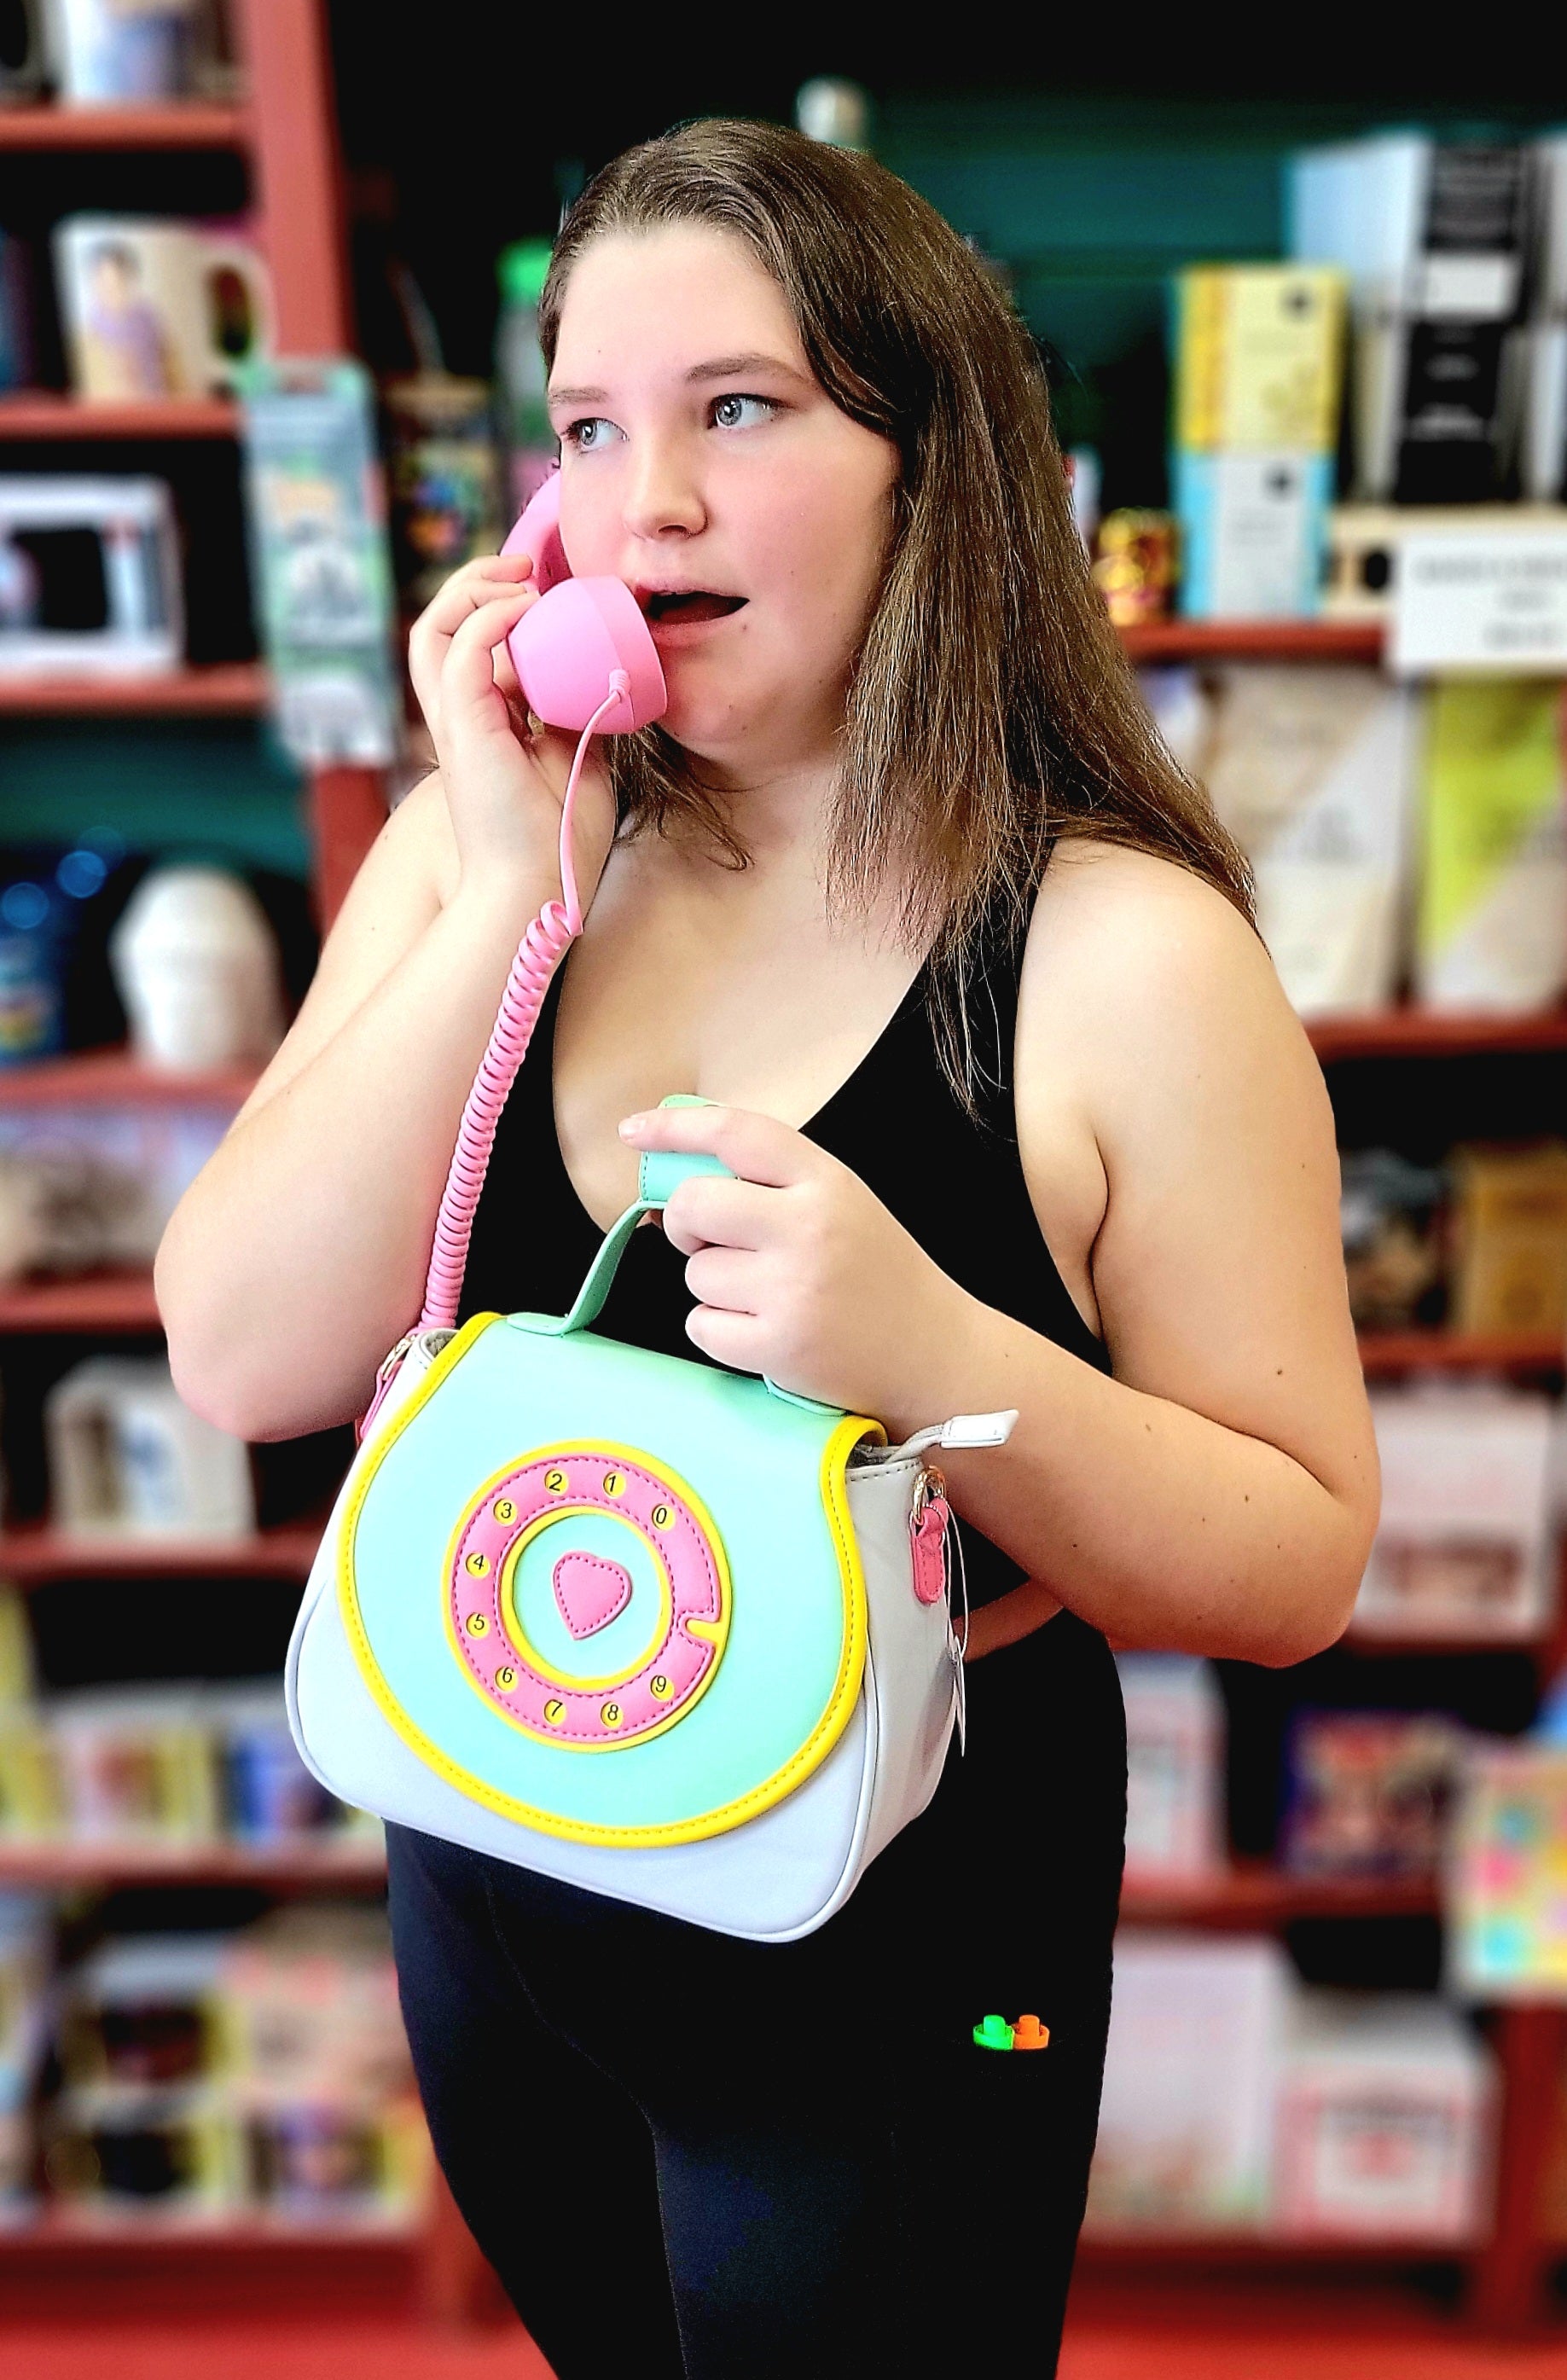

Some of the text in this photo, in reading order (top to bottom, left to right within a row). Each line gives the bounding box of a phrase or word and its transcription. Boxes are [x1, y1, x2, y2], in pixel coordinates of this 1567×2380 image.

[548, 1476, 563, 1492] 2
[608, 1475, 617, 1492] 1
[501, 1502, 513, 1519] 3
[655, 1507, 668, 1524] 0
[473, 1554, 485, 1570] 4
[474, 1613, 485, 1630] 5
[502, 1667, 514, 1683] 6
[655, 1675, 667, 1693] 9
[551, 1702, 563, 1717] 7
[608, 1704, 619, 1721] 8
